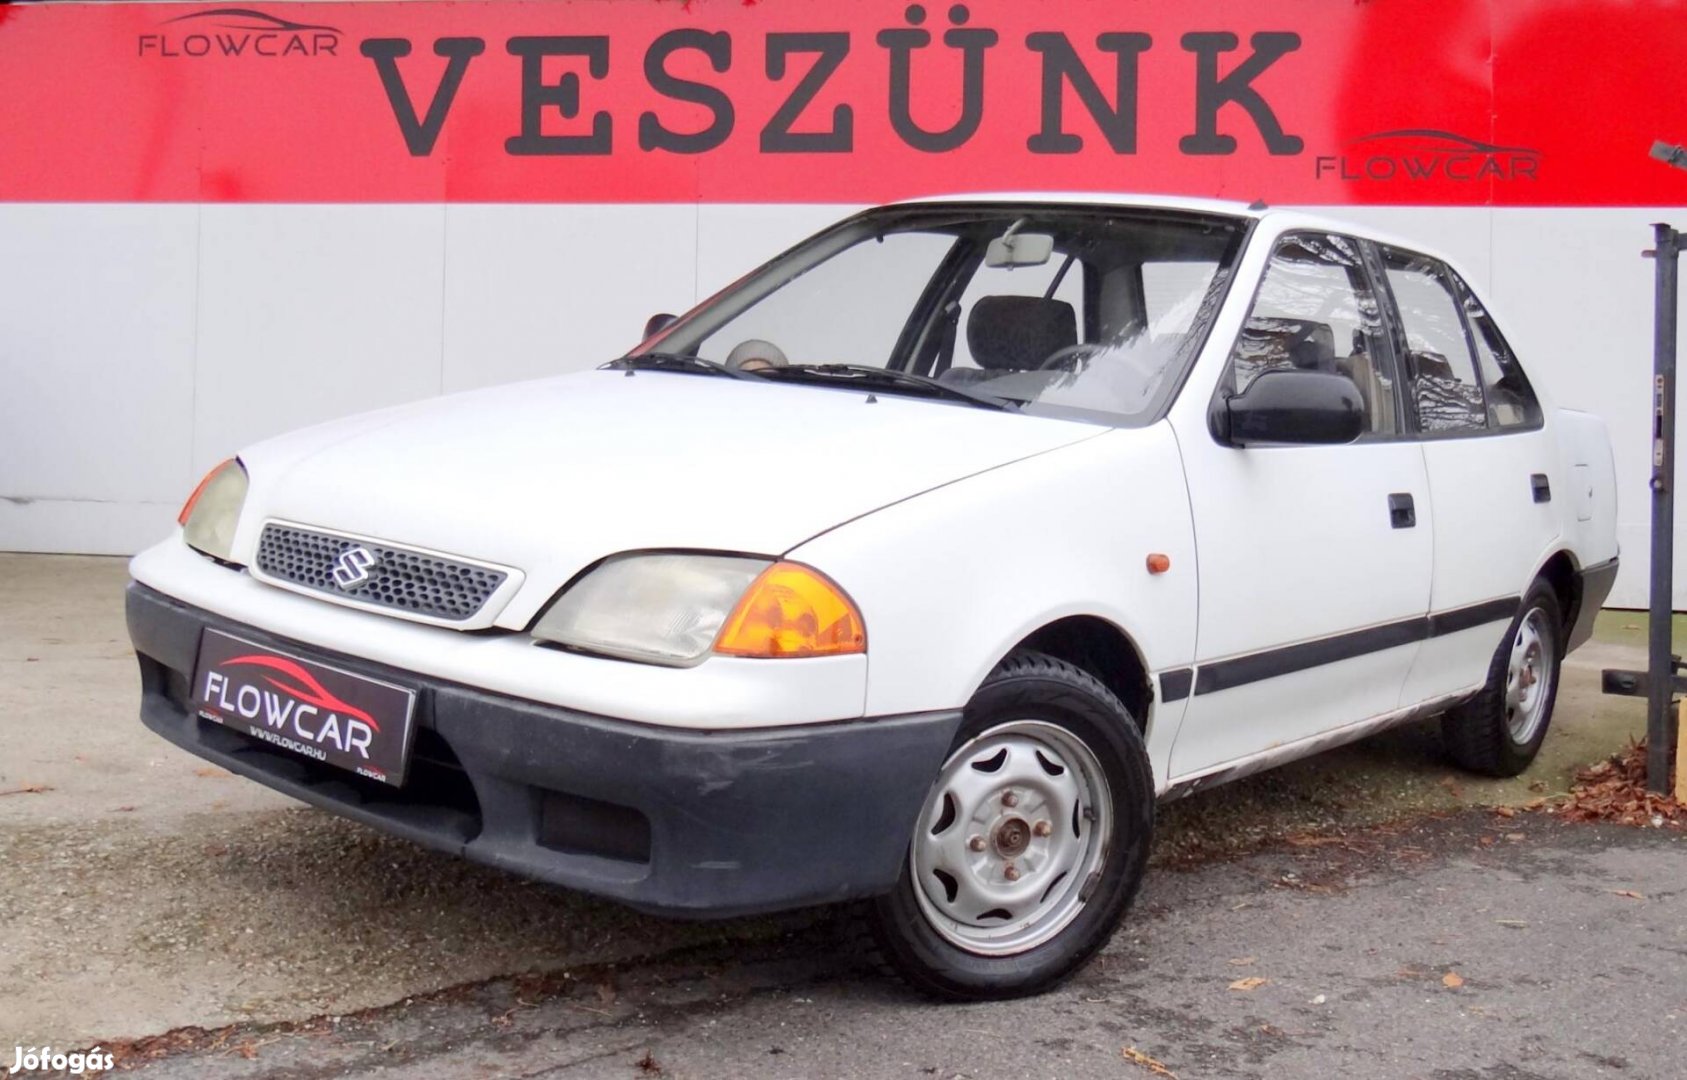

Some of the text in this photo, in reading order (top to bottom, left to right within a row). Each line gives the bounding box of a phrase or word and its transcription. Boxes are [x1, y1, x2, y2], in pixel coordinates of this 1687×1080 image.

[138, 34, 339, 57] FLOWCAR
[359, 4, 1304, 157] VESZÜNK
[1316, 155, 1540, 180] FLOWCAR
[203, 670, 373, 760] FLOWCAR
[249, 726, 327, 761] WWW.FLOWCAR.HU
